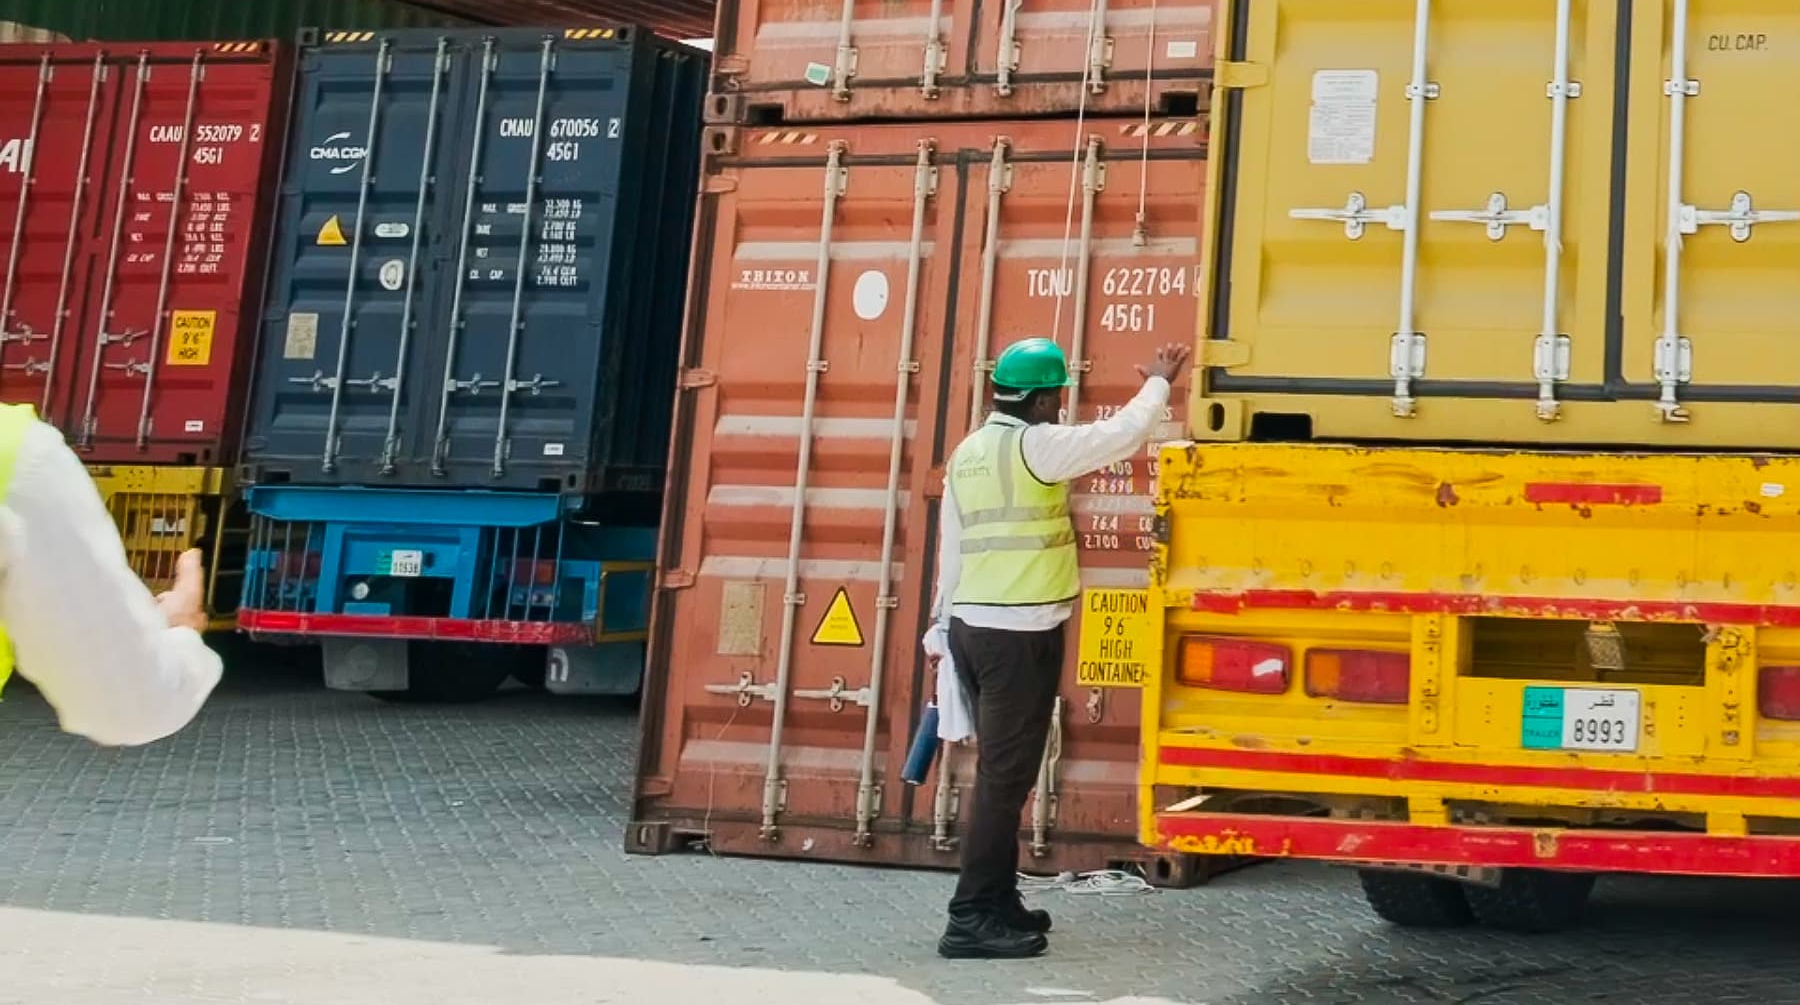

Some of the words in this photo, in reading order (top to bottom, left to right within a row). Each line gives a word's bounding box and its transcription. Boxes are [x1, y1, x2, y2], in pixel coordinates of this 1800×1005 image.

[150, 125, 184, 142] CAAU
[196, 125, 243, 142] 552079
[500, 118, 534, 137] CMAU
[550, 118, 599, 137] 670056
[194, 146, 223, 164] 45G1
[310, 146, 340, 160] CMA
[547, 142, 579, 161] 45G1
[742, 269, 809, 283] TRITON
[1028, 268, 1073, 297] TCNU
[1103, 266, 1185, 296] 622784
[175, 315, 210, 329] CAUTION
[1100, 303, 1155, 332] 45G1
[1090, 593, 1148, 613] CAUTION
[1100, 638, 1133, 660] HIGH
[1573, 717, 1626, 745] 8993
